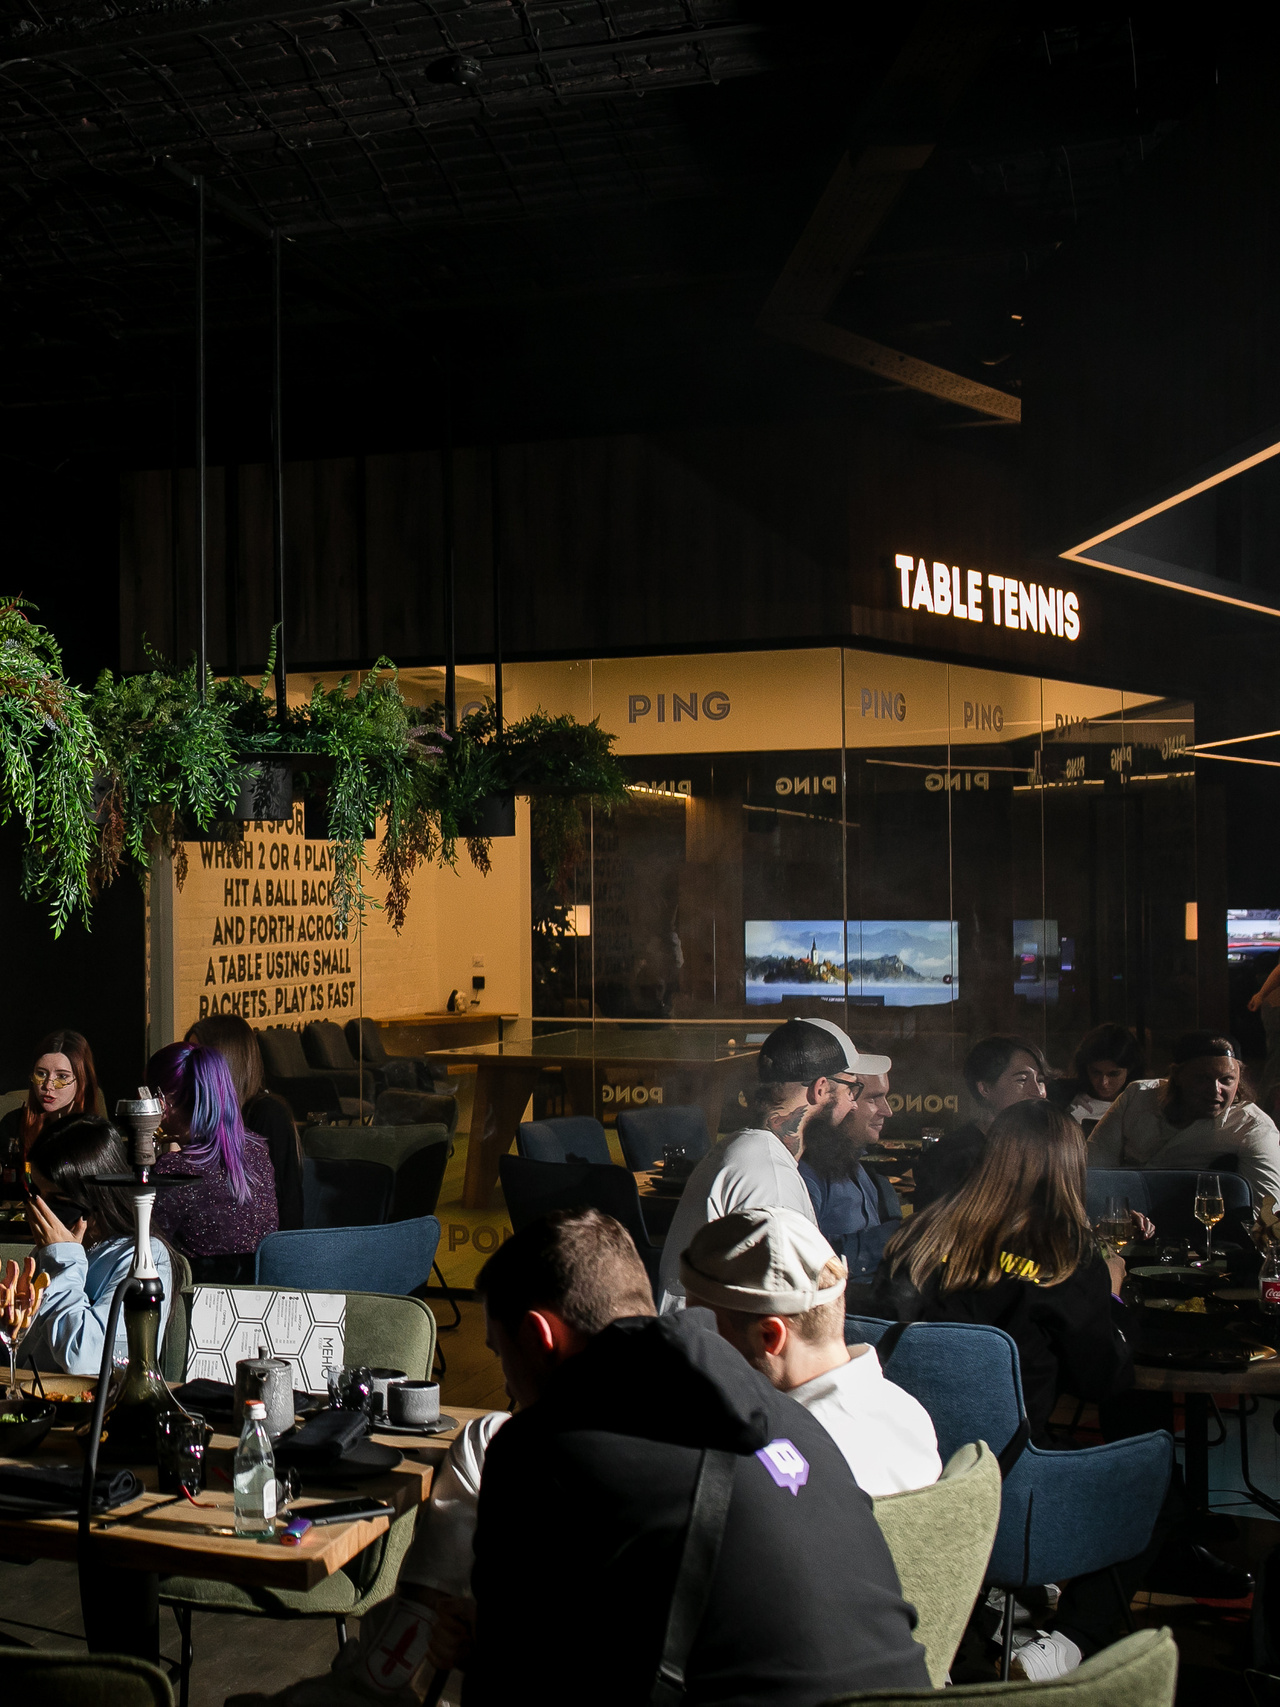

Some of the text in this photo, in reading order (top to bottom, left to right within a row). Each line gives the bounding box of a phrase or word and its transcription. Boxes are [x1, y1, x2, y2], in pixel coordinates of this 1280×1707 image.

[895, 554, 1080, 641] TABLE TENNIS
[628, 691, 731, 723] PING
[860, 688, 906, 722] PING
[963, 701, 1004, 732] PING
[200, 841, 253, 869] WHICH
[258, 842, 266, 870] 2
[270, 842, 289, 870] OR
[293, 844, 301, 870] 4
[224, 878, 249, 907] HIT
[252, 879, 262, 906] A
[266, 879, 297, 906] BALL
[212, 916, 245, 945] AND
[249, 914, 294, 944] FORTH
[205, 948, 351, 986] A TABLE USING SMALL
[275, 984, 308, 1015] PLAY
[310, 983, 324, 1011] IS
[327, 981, 356, 1009] FAST
